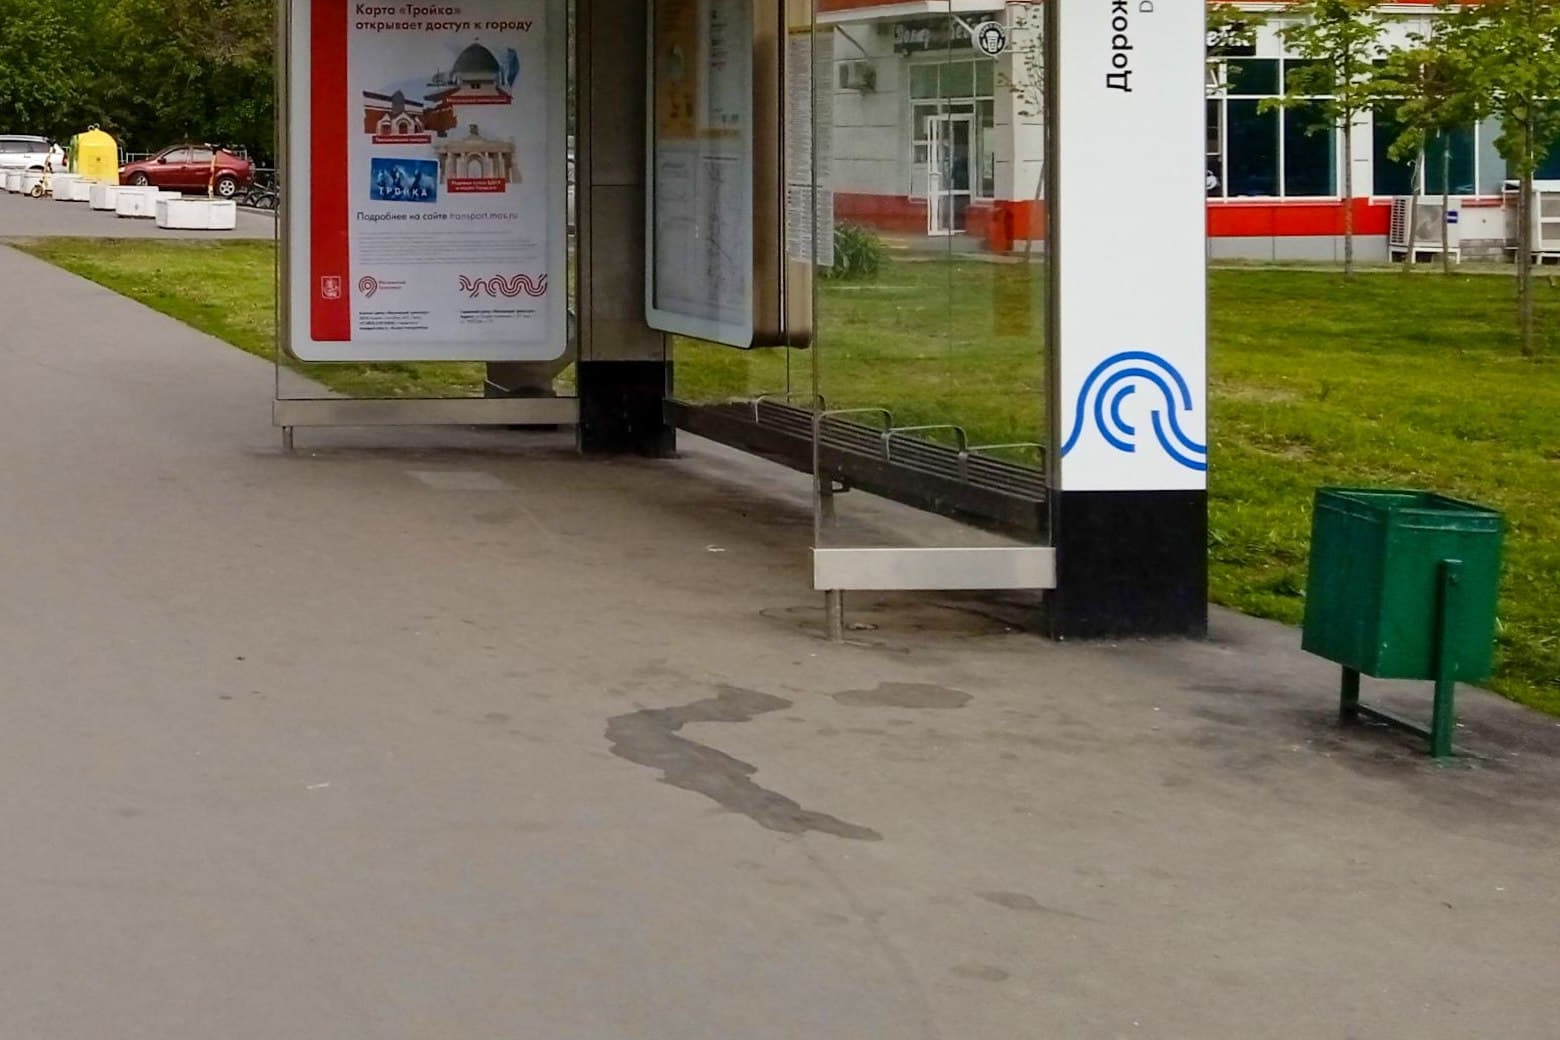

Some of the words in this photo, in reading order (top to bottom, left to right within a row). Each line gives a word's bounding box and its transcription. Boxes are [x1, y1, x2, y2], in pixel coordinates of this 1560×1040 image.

[355, 3, 396, 18] Карта
[399, 3, 461, 18] «Тройка»
[355, 21, 422, 32] открывает
[425, 21, 470, 32] доступ
[473, 21, 482, 30] к
[485, 20, 533, 32] городу
[356, 211, 408, 222] Подробнее
[409, 213, 420, 221] на
[422, 211, 448, 221] сайте
